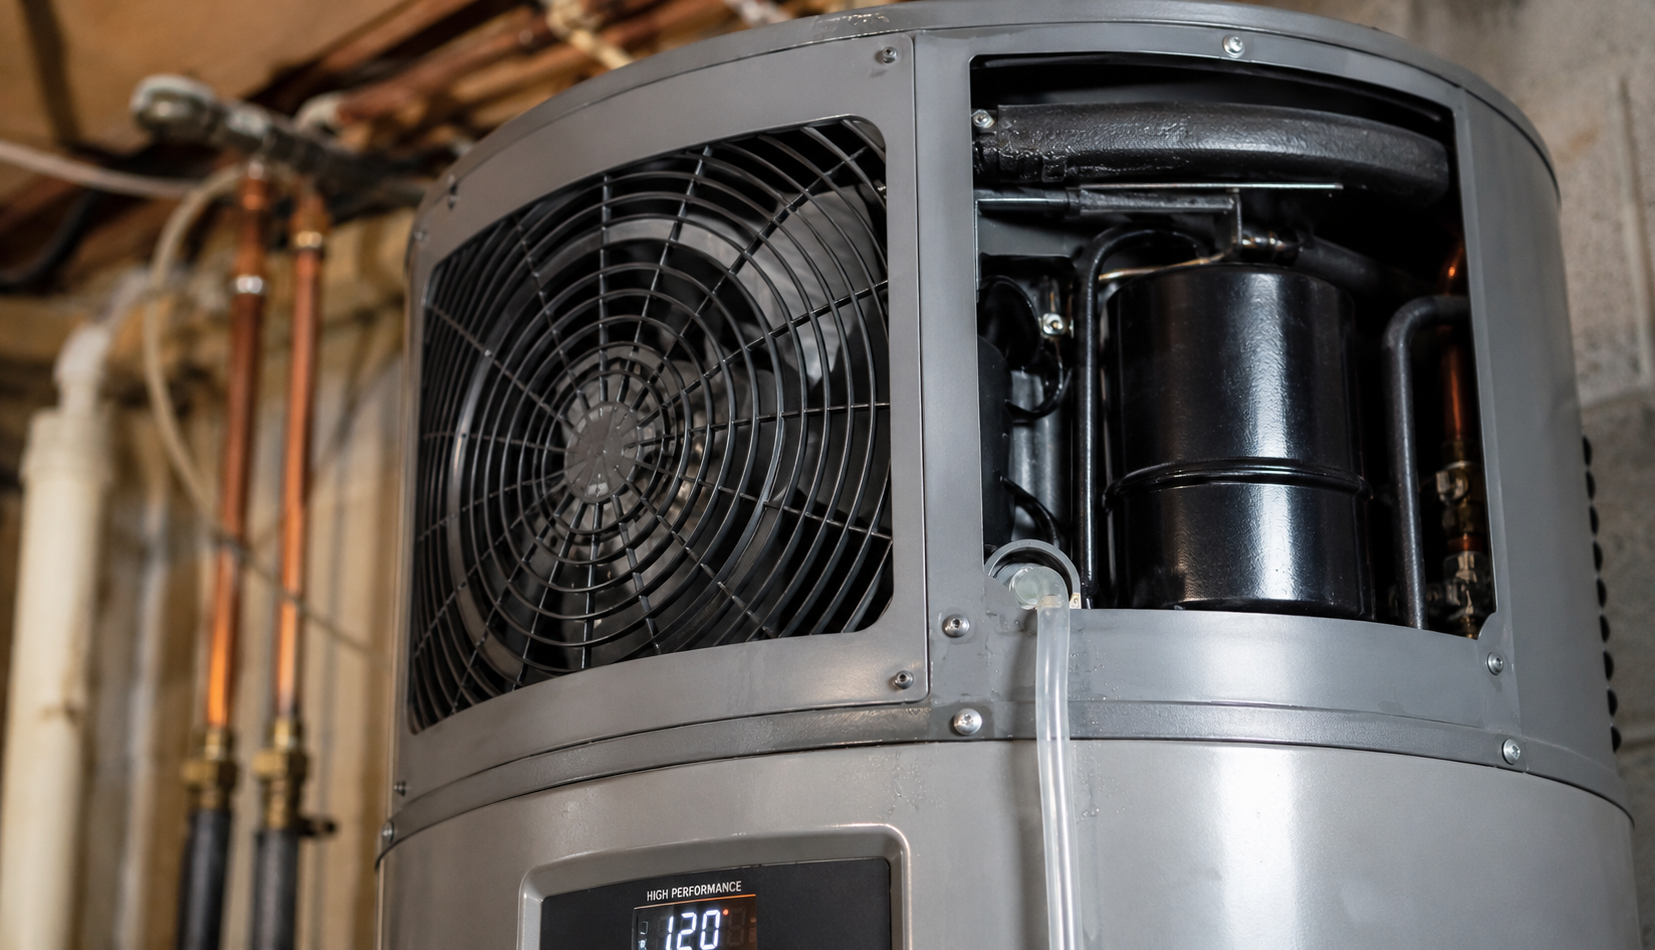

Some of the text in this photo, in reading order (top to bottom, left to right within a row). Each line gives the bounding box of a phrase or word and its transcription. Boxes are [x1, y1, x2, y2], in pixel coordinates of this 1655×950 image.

[646, 880, 742, 902] HIGH PERFORMANCE
[665, 909, 721, 950] 120
